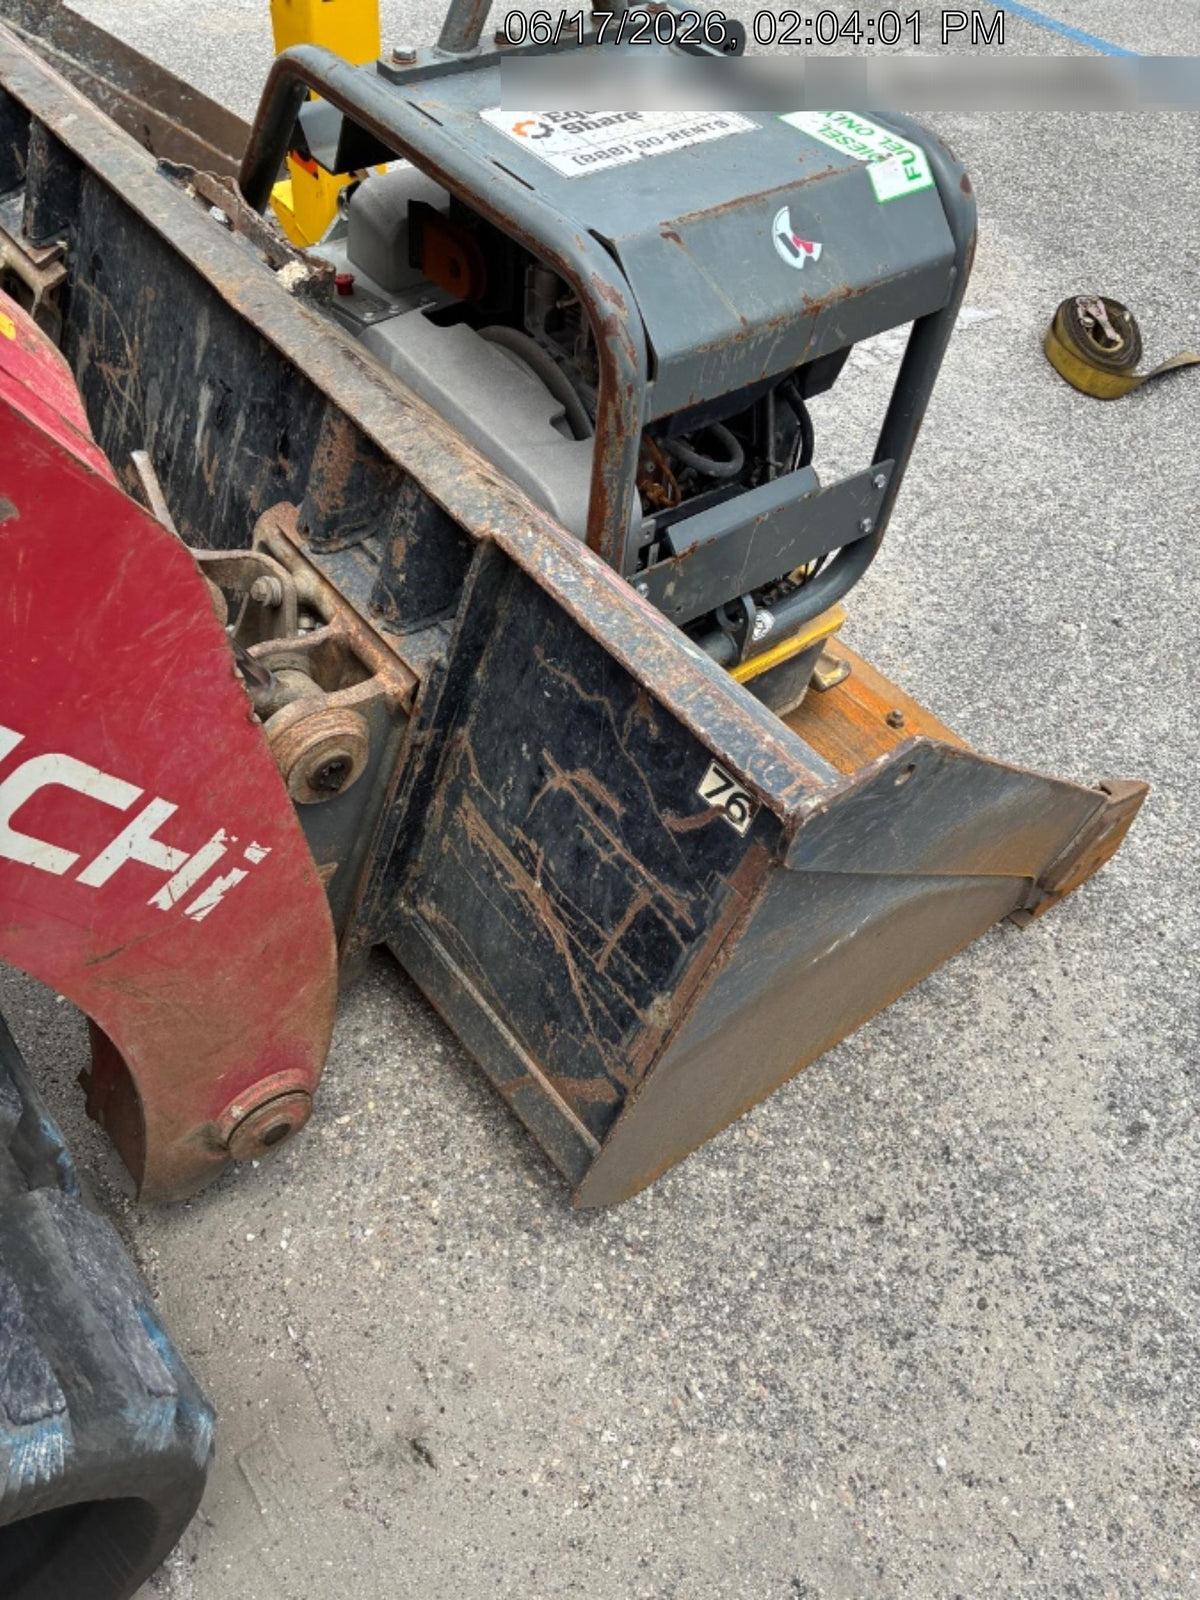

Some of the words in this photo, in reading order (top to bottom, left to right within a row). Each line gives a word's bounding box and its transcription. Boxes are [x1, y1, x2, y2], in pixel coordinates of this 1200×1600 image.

[560, 111, 644, 134] Share
[878, 136, 923, 181] FUEL
[704, 765, 756, 825] 76
[0, 725, 272, 922] CHI
